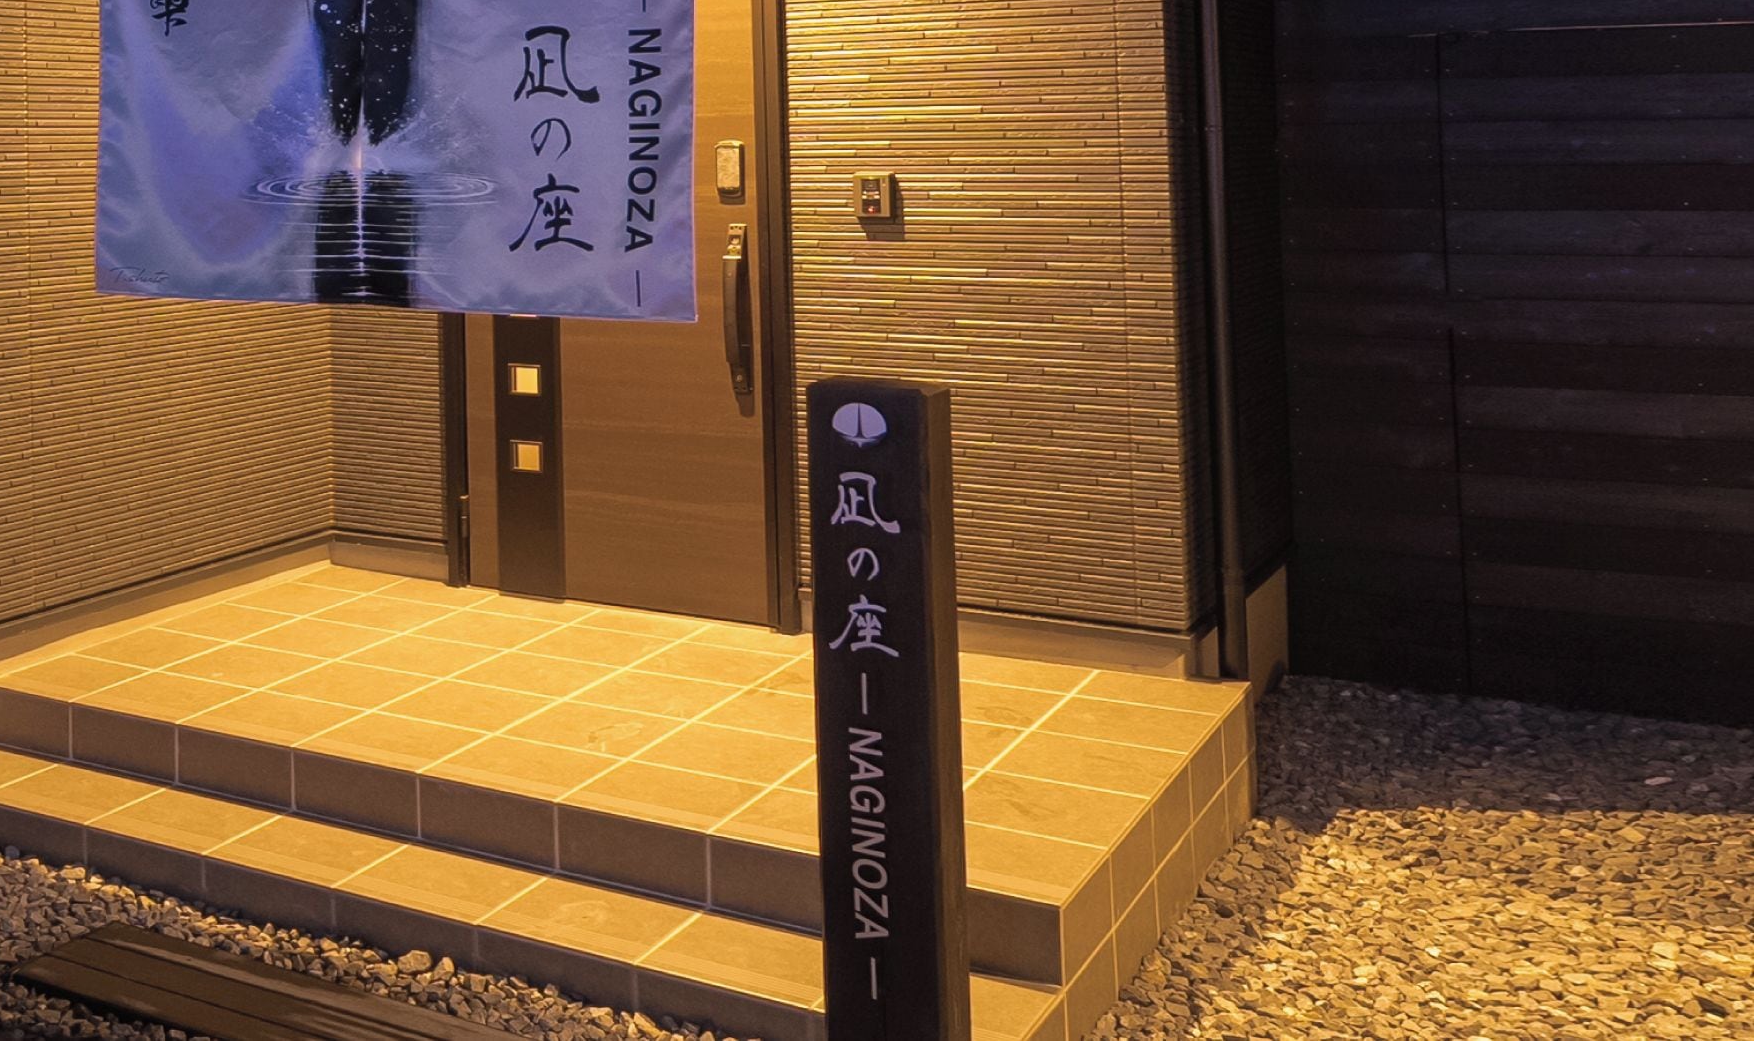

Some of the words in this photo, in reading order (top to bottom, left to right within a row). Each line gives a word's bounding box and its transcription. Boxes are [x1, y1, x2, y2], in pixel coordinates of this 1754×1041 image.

[508, 24, 601, 252] 凪の座
[624, 27, 663, 253] NAGINOZA
[828, 470, 902, 658] 凪の座
[847, 726, 890, 940] NAGINOZA
